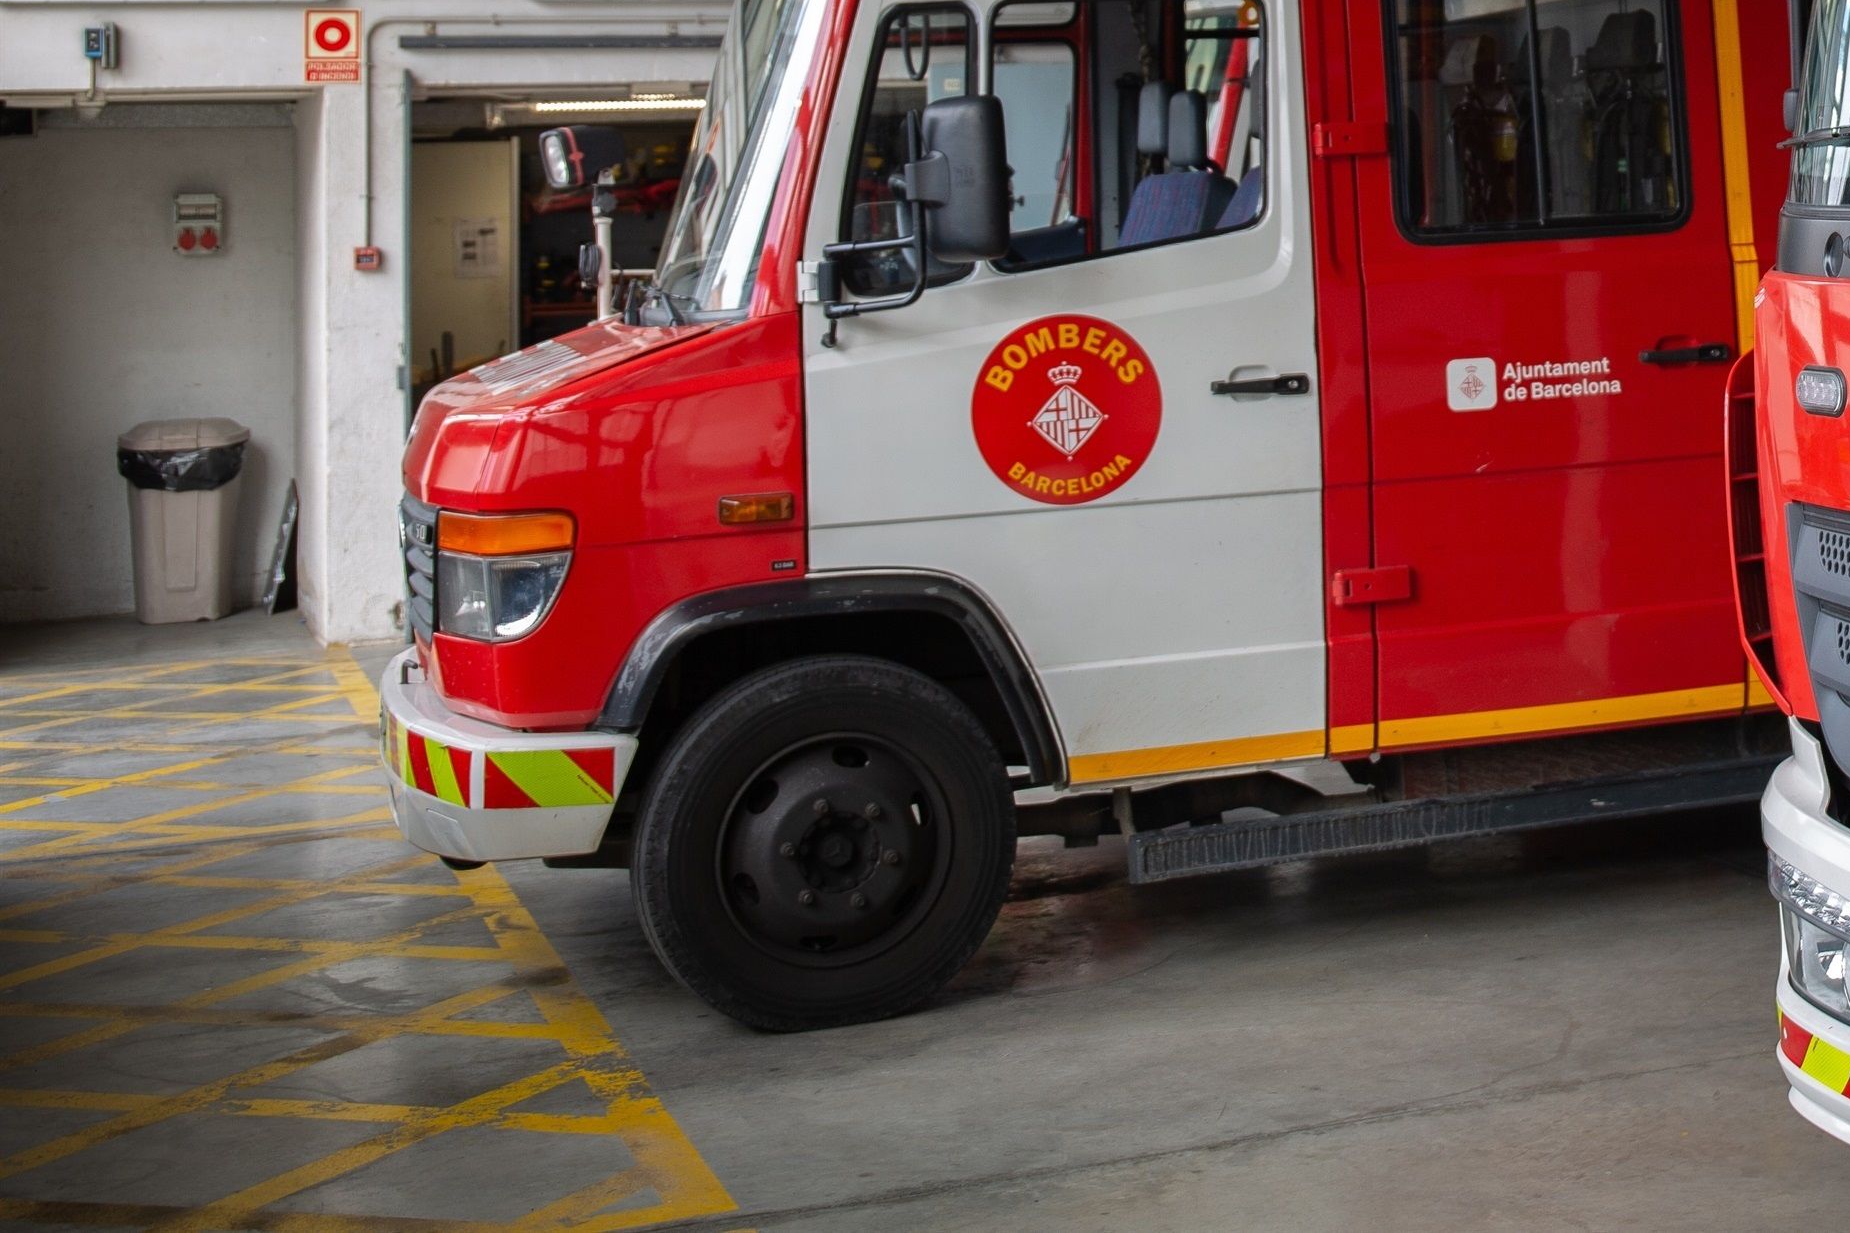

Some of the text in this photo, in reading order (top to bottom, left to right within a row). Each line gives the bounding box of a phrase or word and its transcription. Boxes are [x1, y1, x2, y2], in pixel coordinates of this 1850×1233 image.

[985, 323, 1144, 392] BOMBERS
[1502, 357, 1611, 383] Ajuntament
[1504, 379, 1622, 402] de Barcelona
[1008, 454, 1132, 496] BARCELONA
